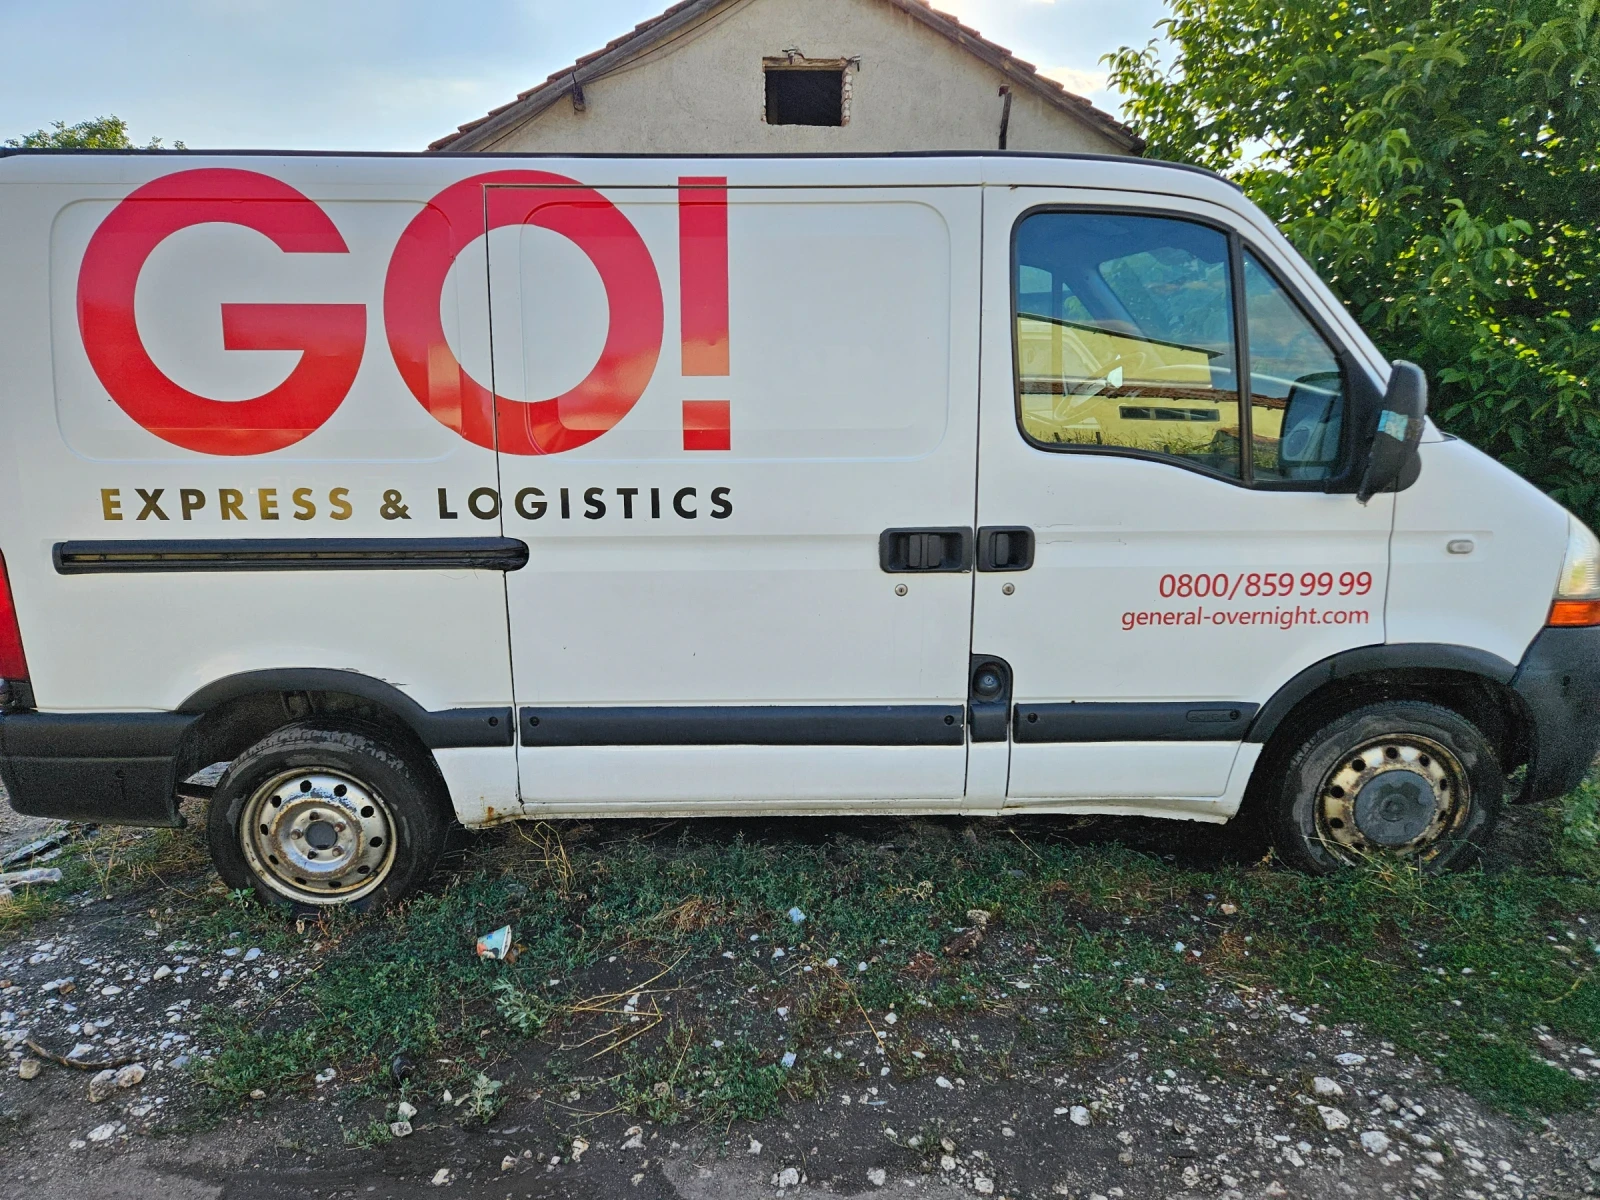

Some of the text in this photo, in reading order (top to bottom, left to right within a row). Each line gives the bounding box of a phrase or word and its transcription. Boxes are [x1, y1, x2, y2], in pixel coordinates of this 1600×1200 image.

[77, 168, 730, 456] GO!
[100, 486, 733, 521] EXPRESS & LOGISTICS
[1159, 571, 1373, 600] 0800/859 99 99
[1121, 606, 1369, 630] general-overnight.com
